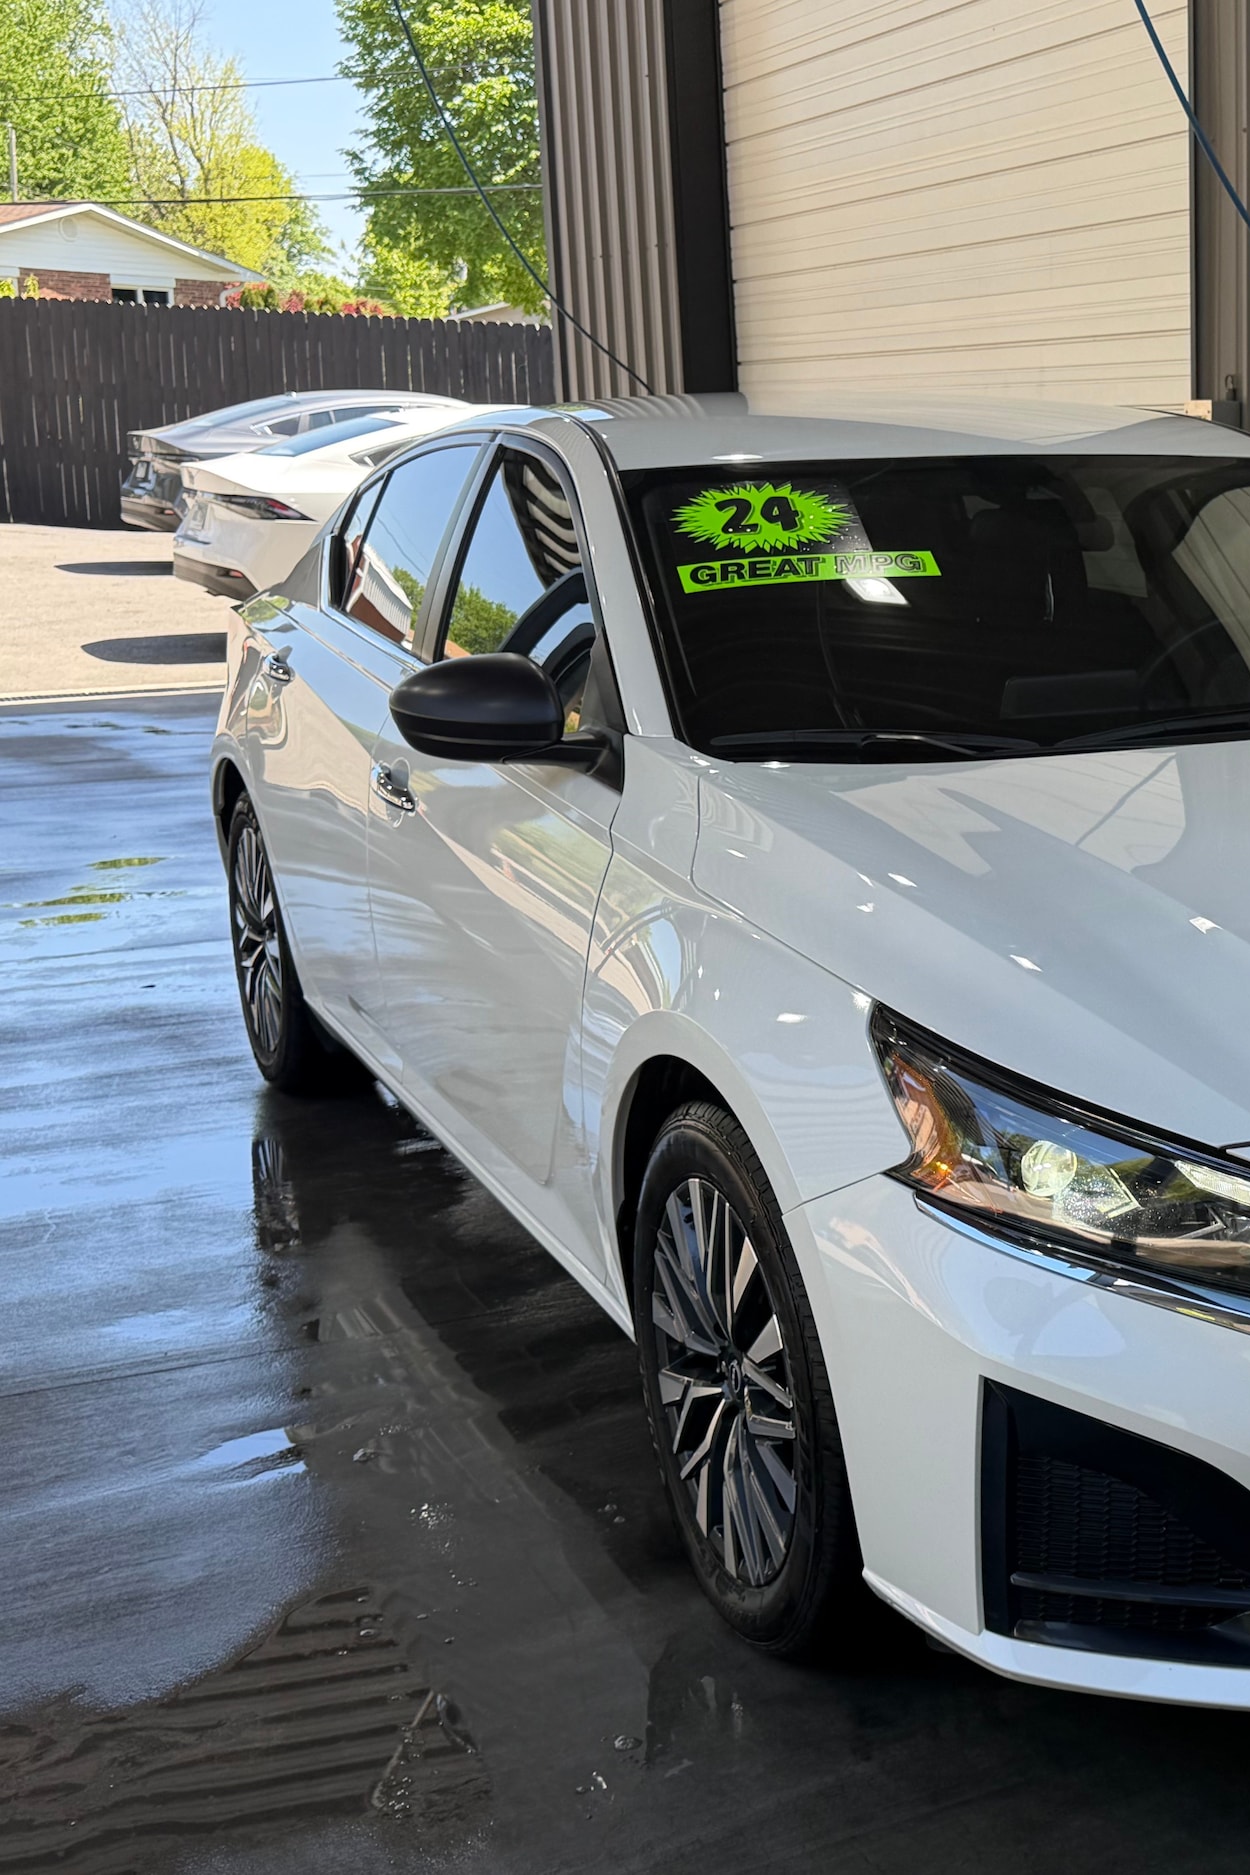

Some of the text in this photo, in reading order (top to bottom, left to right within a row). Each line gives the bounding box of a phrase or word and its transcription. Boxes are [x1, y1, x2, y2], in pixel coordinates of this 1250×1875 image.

[715, 496, 802, 535] 24
[689, 553, 923, 585] GREAT MPG
